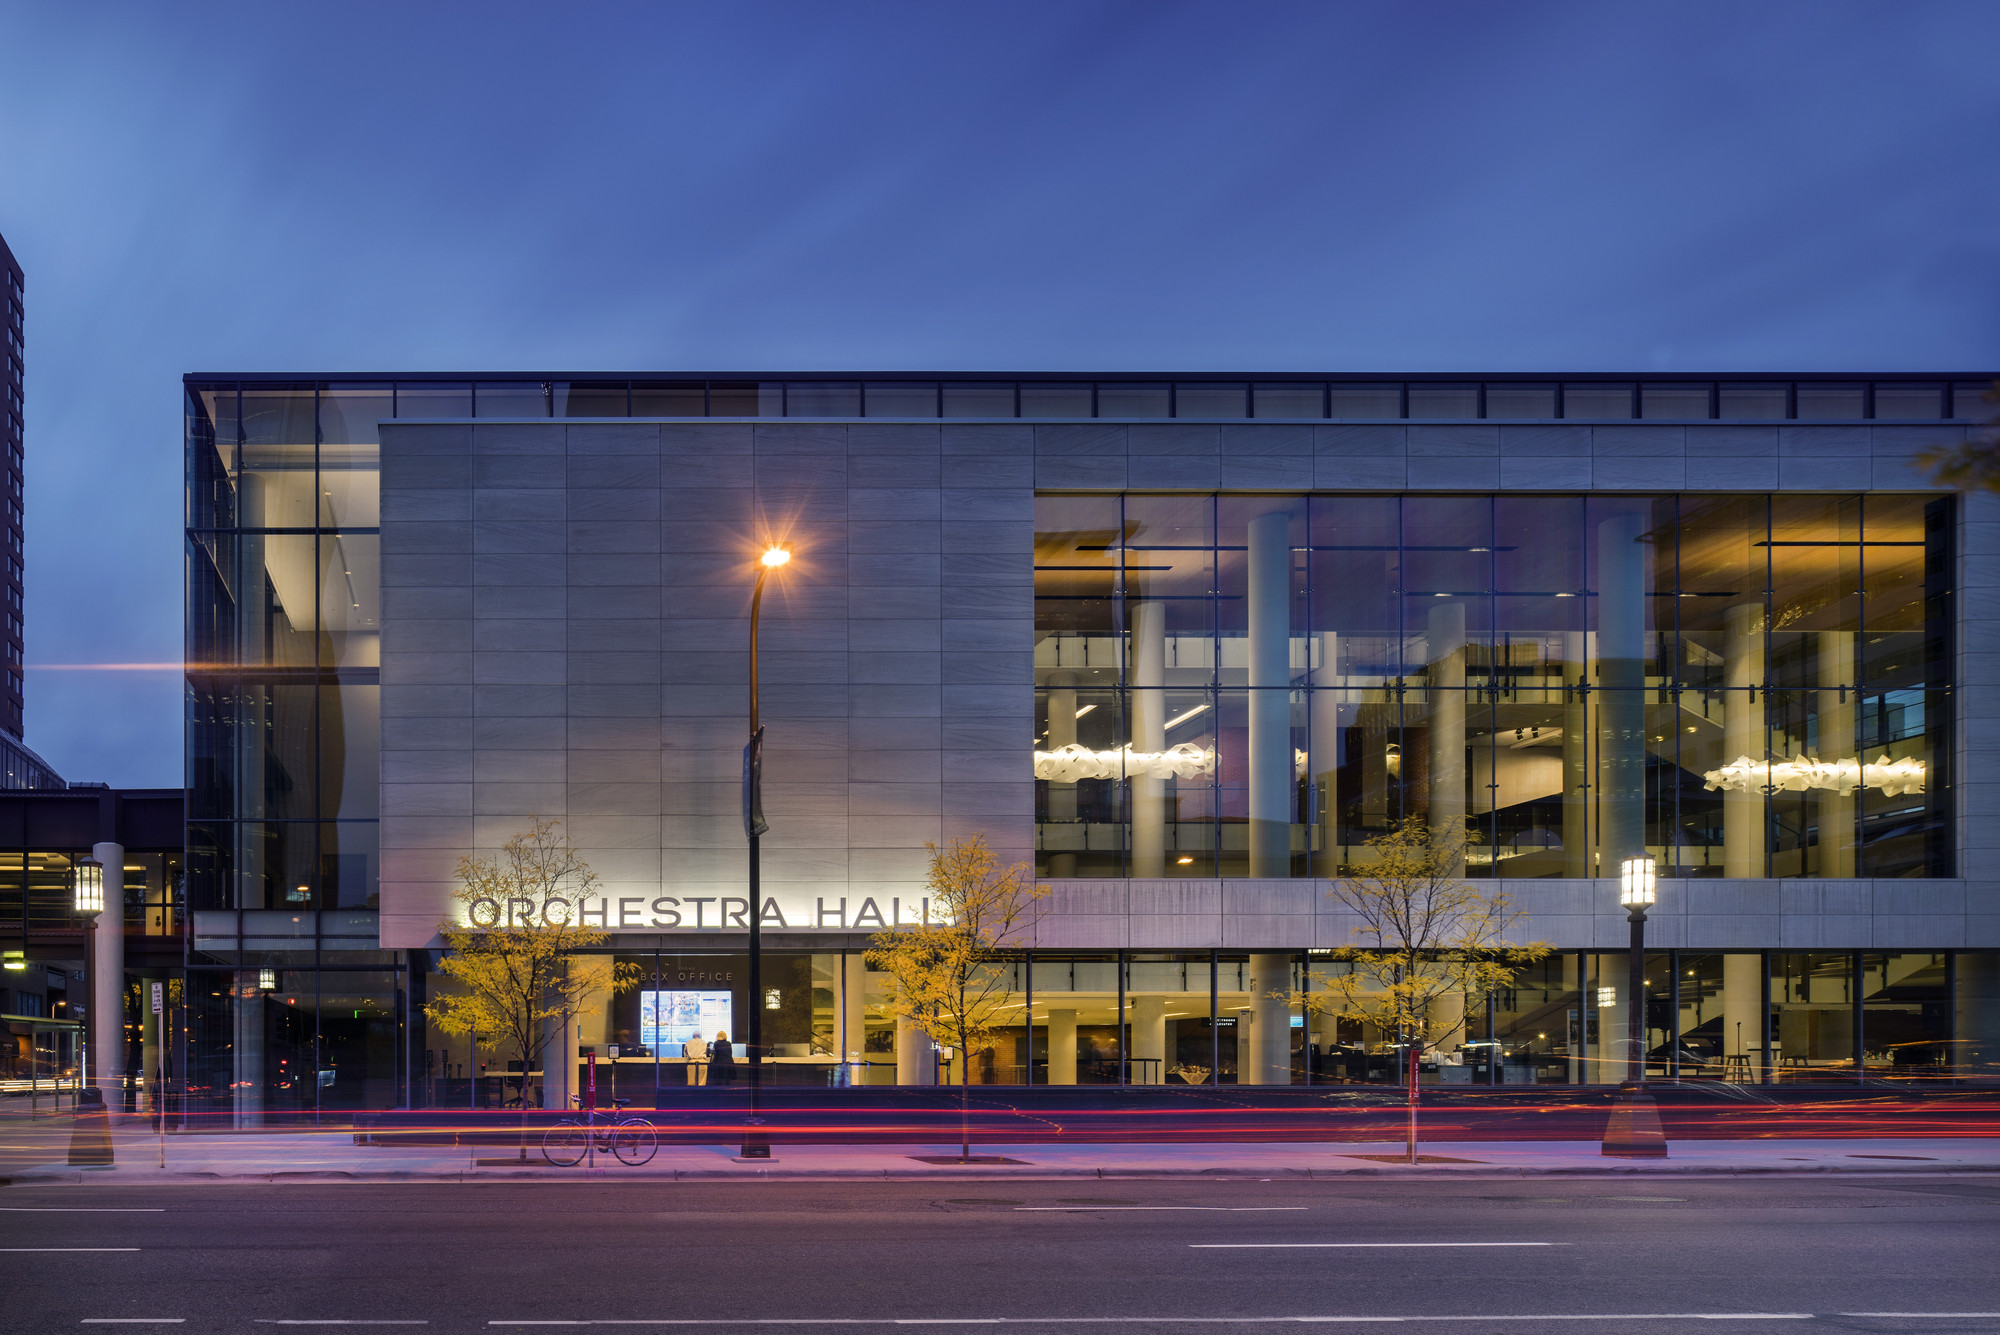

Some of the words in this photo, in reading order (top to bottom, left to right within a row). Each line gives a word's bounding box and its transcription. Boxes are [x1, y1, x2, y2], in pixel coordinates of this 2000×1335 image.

[469, 897, 788, 929] ORCHESTRA
[817, 897, 949, 929] HALL
[640, 972, 668, 981] BOX
[678, 972, 733, 981] OFFICE
